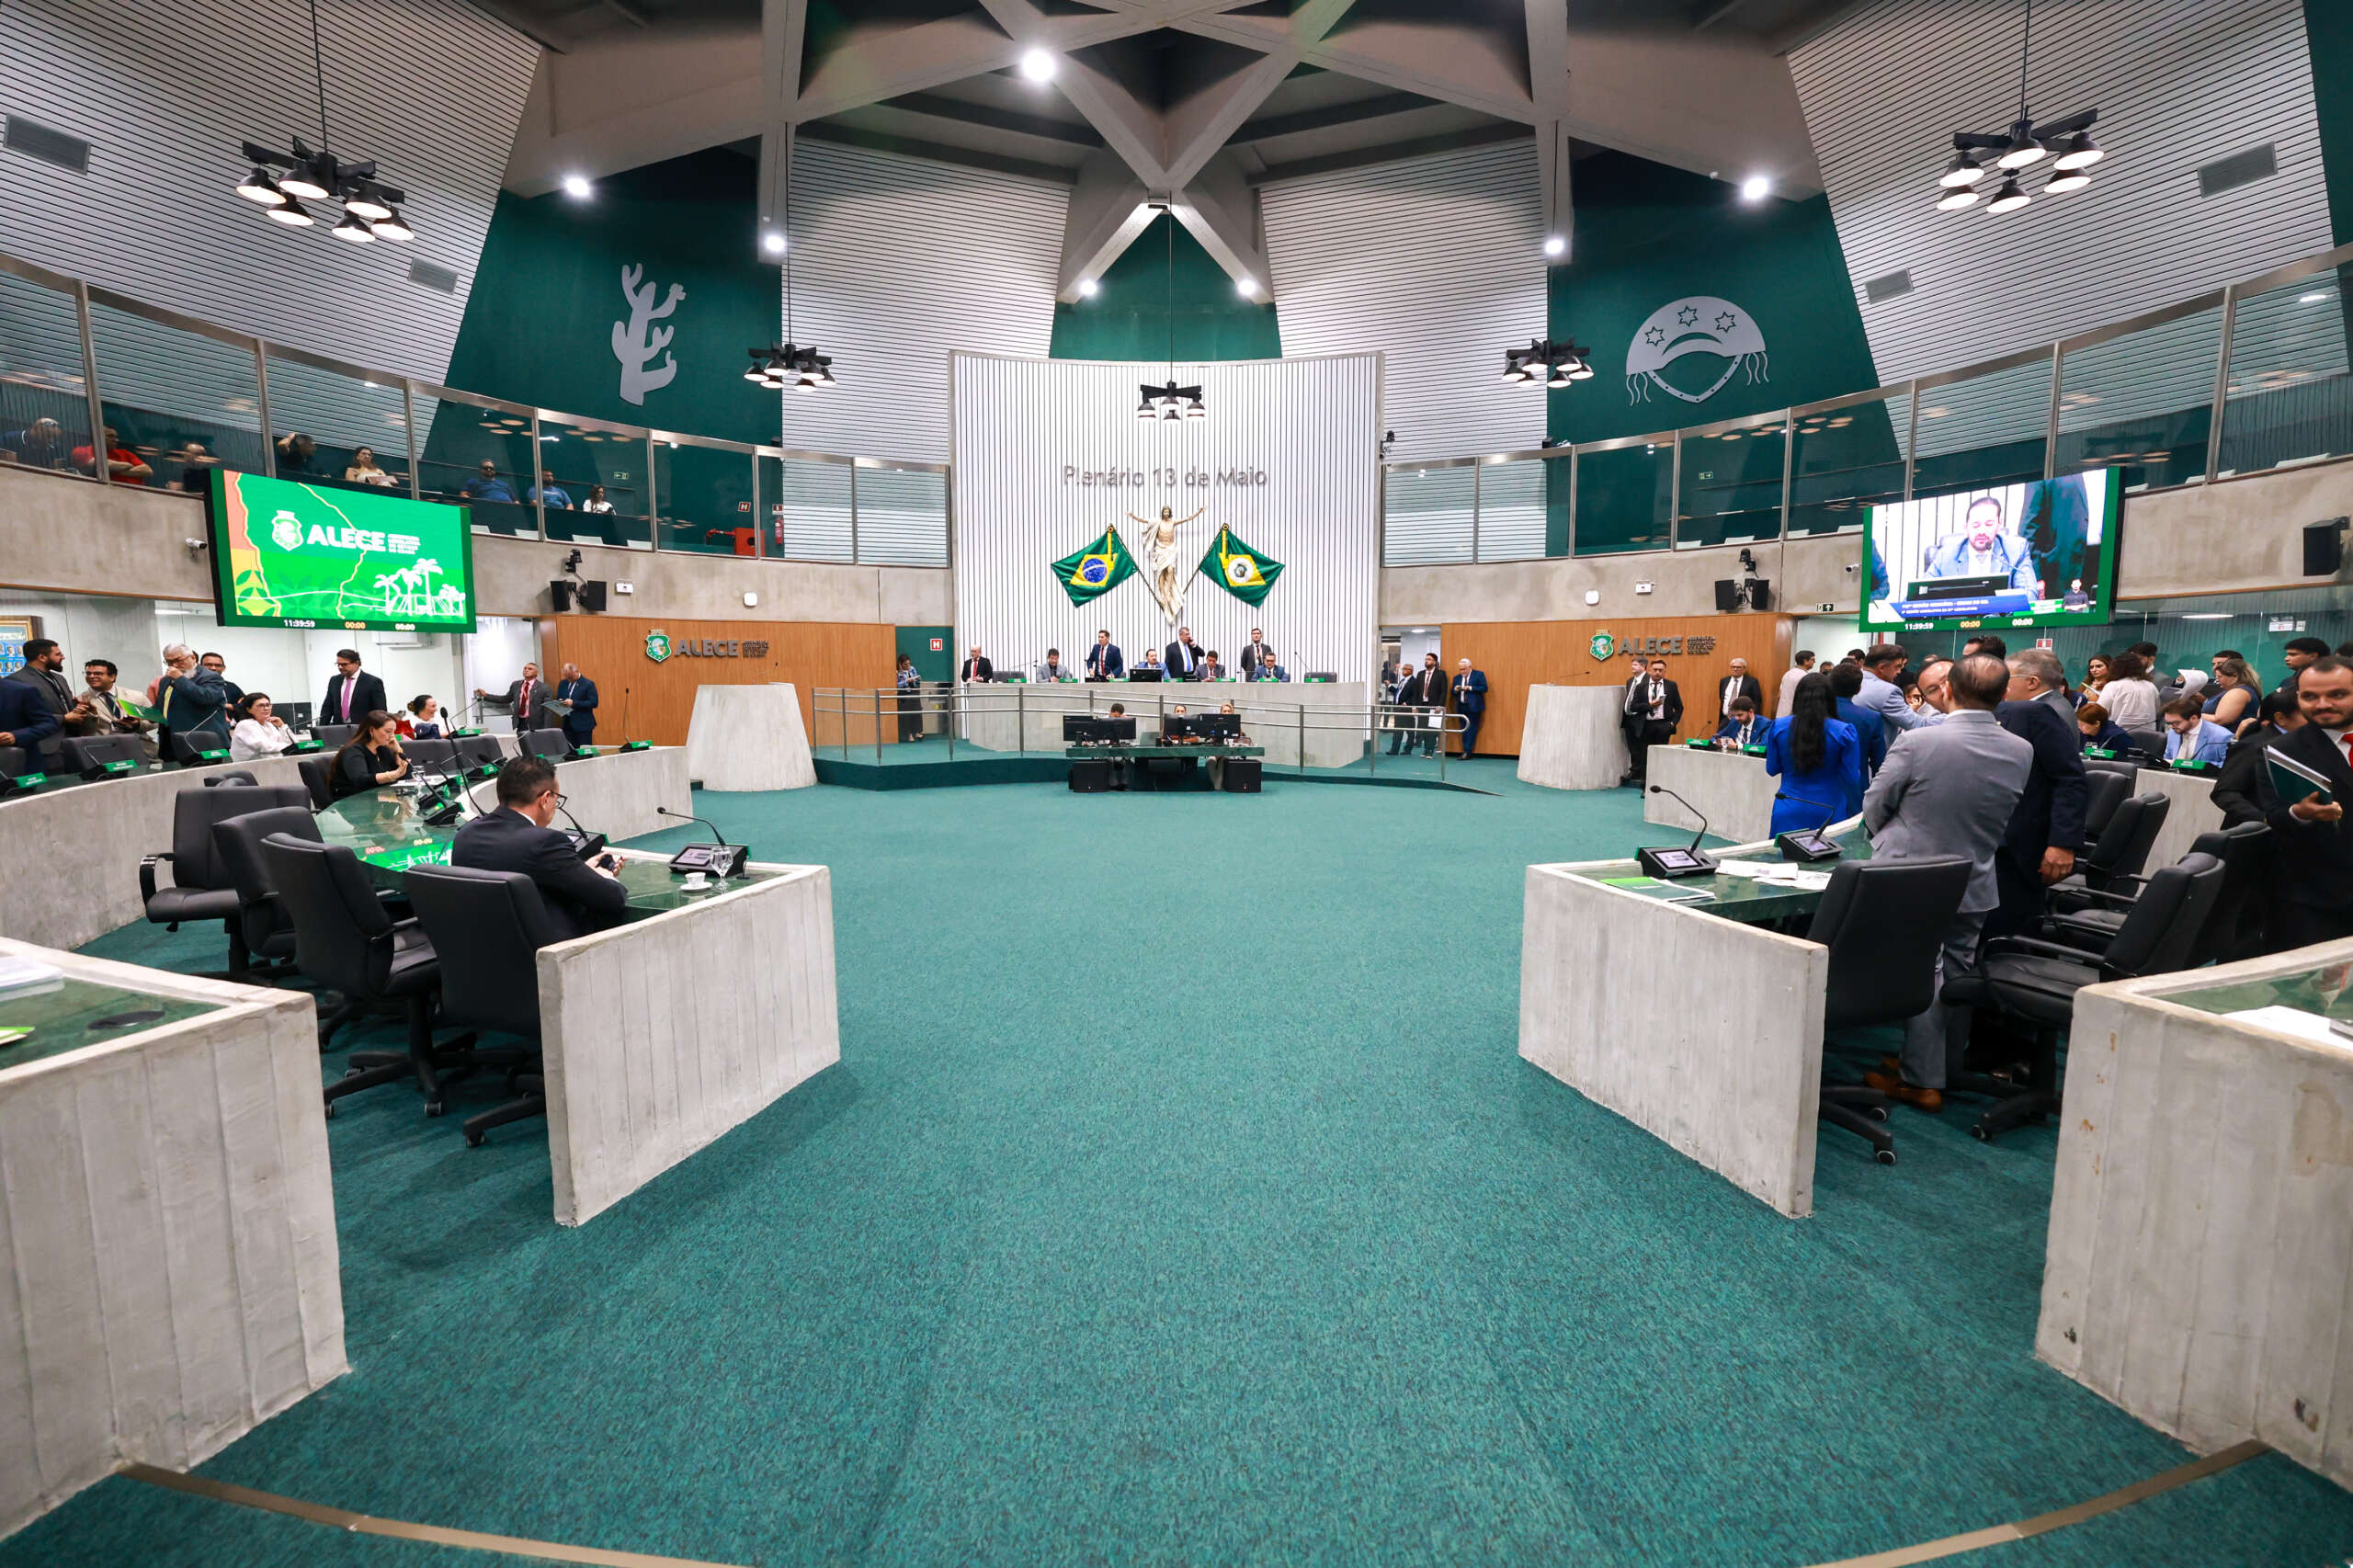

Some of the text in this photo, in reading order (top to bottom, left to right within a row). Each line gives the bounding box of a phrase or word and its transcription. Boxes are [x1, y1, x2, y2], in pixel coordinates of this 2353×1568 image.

[1063, 465, 1268, 487] Plenário 13 de Maio
[307, 524, 386, 551] ALECE
[284, 619, 315, 628] 11:39:59
[345, 621, 366, 630] 00:00
[1904, 618, 2033, 631] 11:39:59 00:00 00:00
[675, 639, 739, 657] ALECE
[1618, 636, 1683, 655] ALECE
